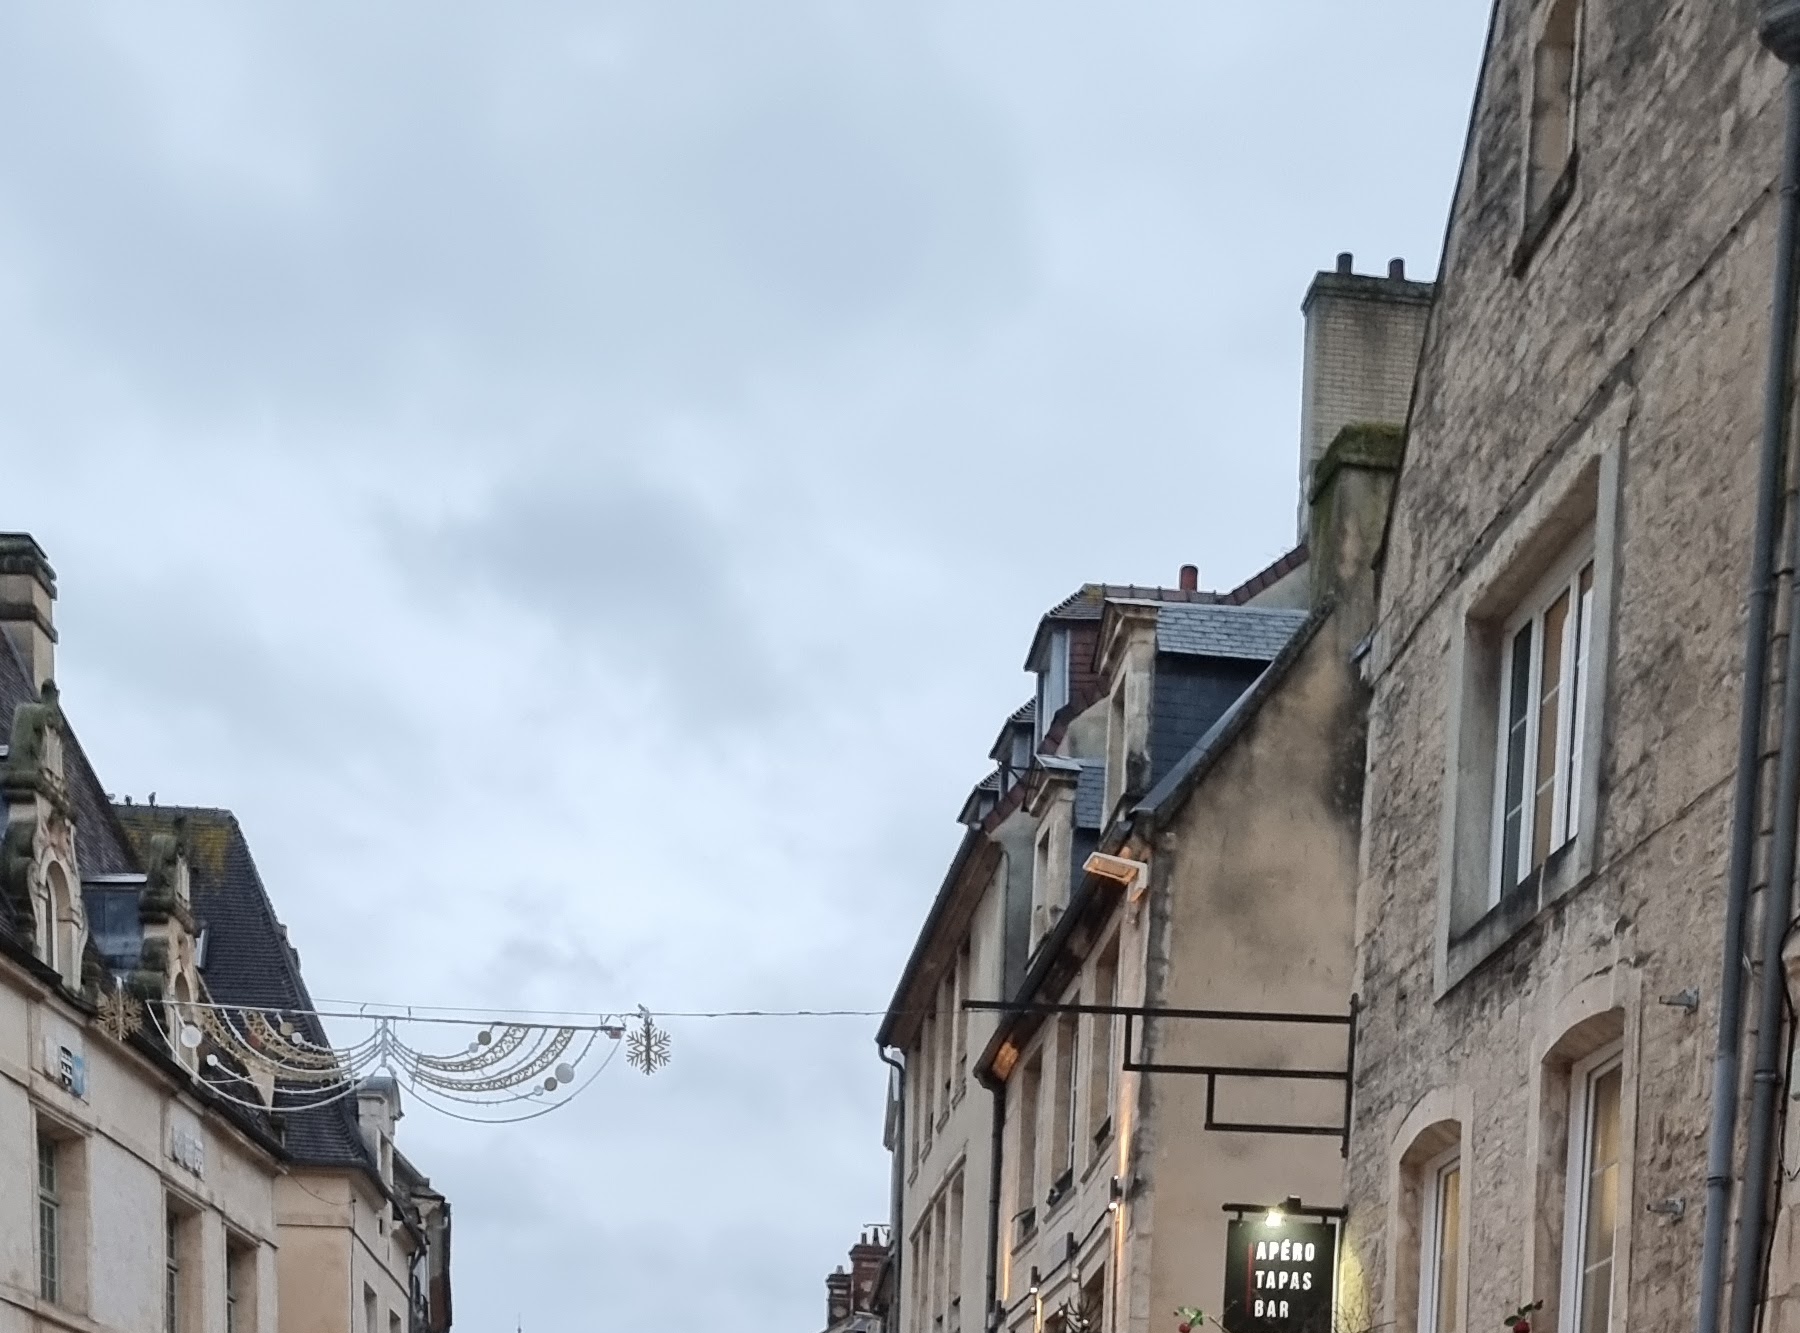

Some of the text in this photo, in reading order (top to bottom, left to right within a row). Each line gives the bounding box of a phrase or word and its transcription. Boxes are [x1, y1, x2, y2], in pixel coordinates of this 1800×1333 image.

[1256, 1239, 1315, 1262] APÉRO
[1255, 1270, 1312, 1291] TAPAS
[1254, 1299, 1289, 1318] BAR
